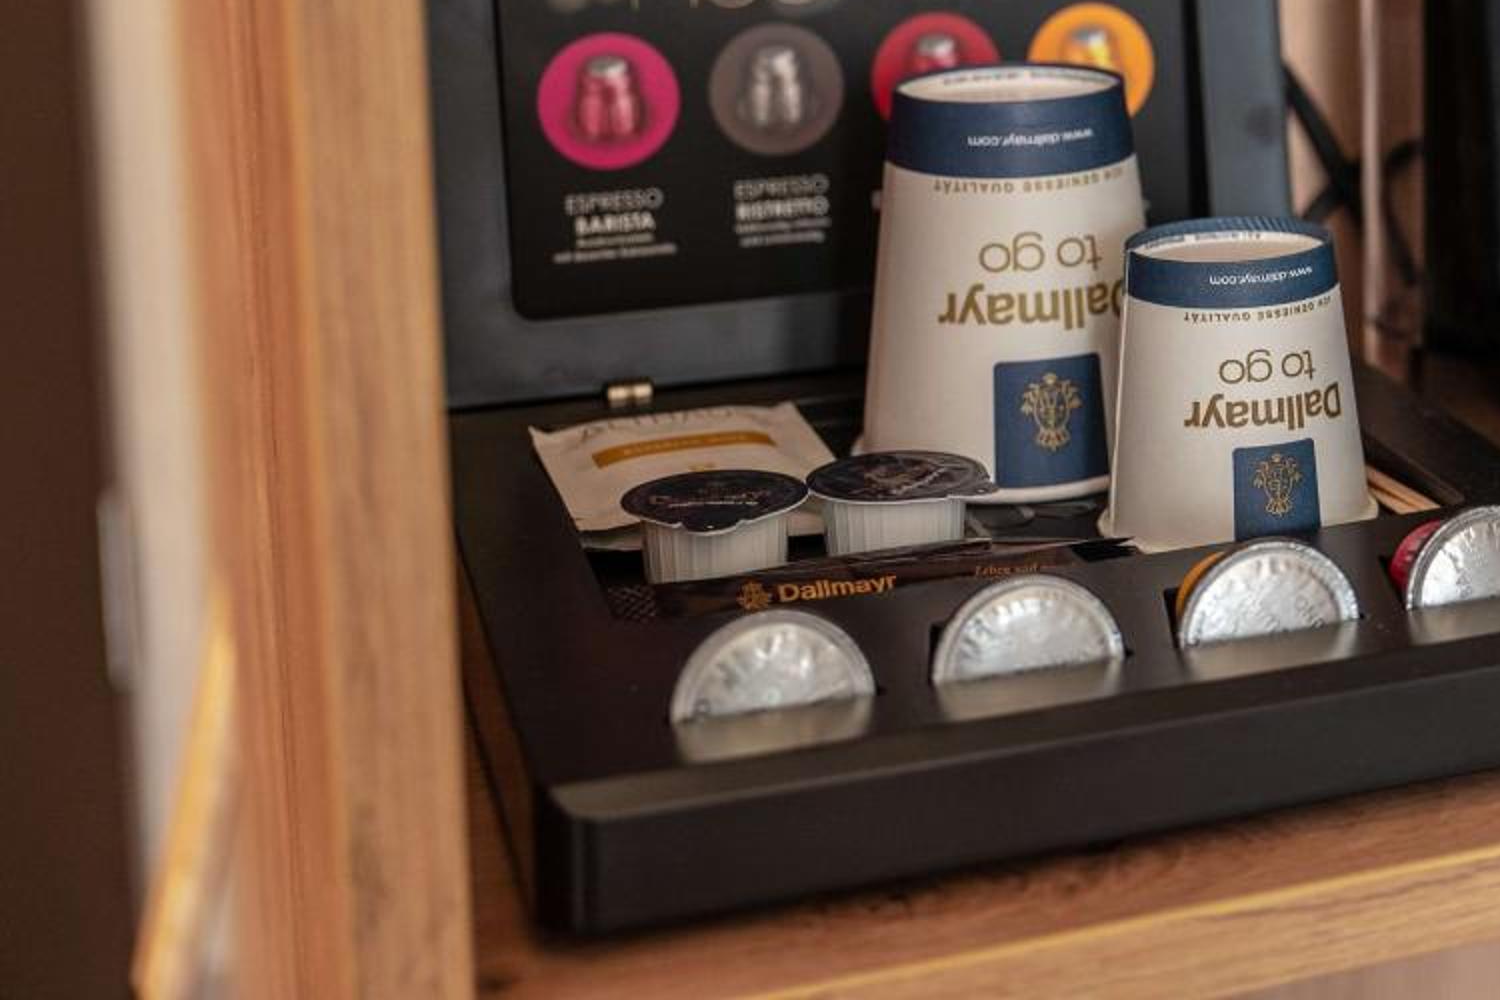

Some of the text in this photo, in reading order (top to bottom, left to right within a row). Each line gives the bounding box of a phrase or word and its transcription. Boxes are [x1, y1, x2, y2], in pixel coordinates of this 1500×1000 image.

[734, 173, 830, 199] ESPRESSO
[932, 179, 1015, 196] QUALITÄT
[564, 188, 664, 216] ESPRESSO
[576, 213, 656, 236] BARISTA
[978, 231, 1102, 274] to go
[1183, 311, 1251, 325] QUALITÄT
[1218, 349, 1317, 386] to go
[1183, 380, 1342, 432] Dallmayr
[777, 573, 897, 604] Dallmayr
